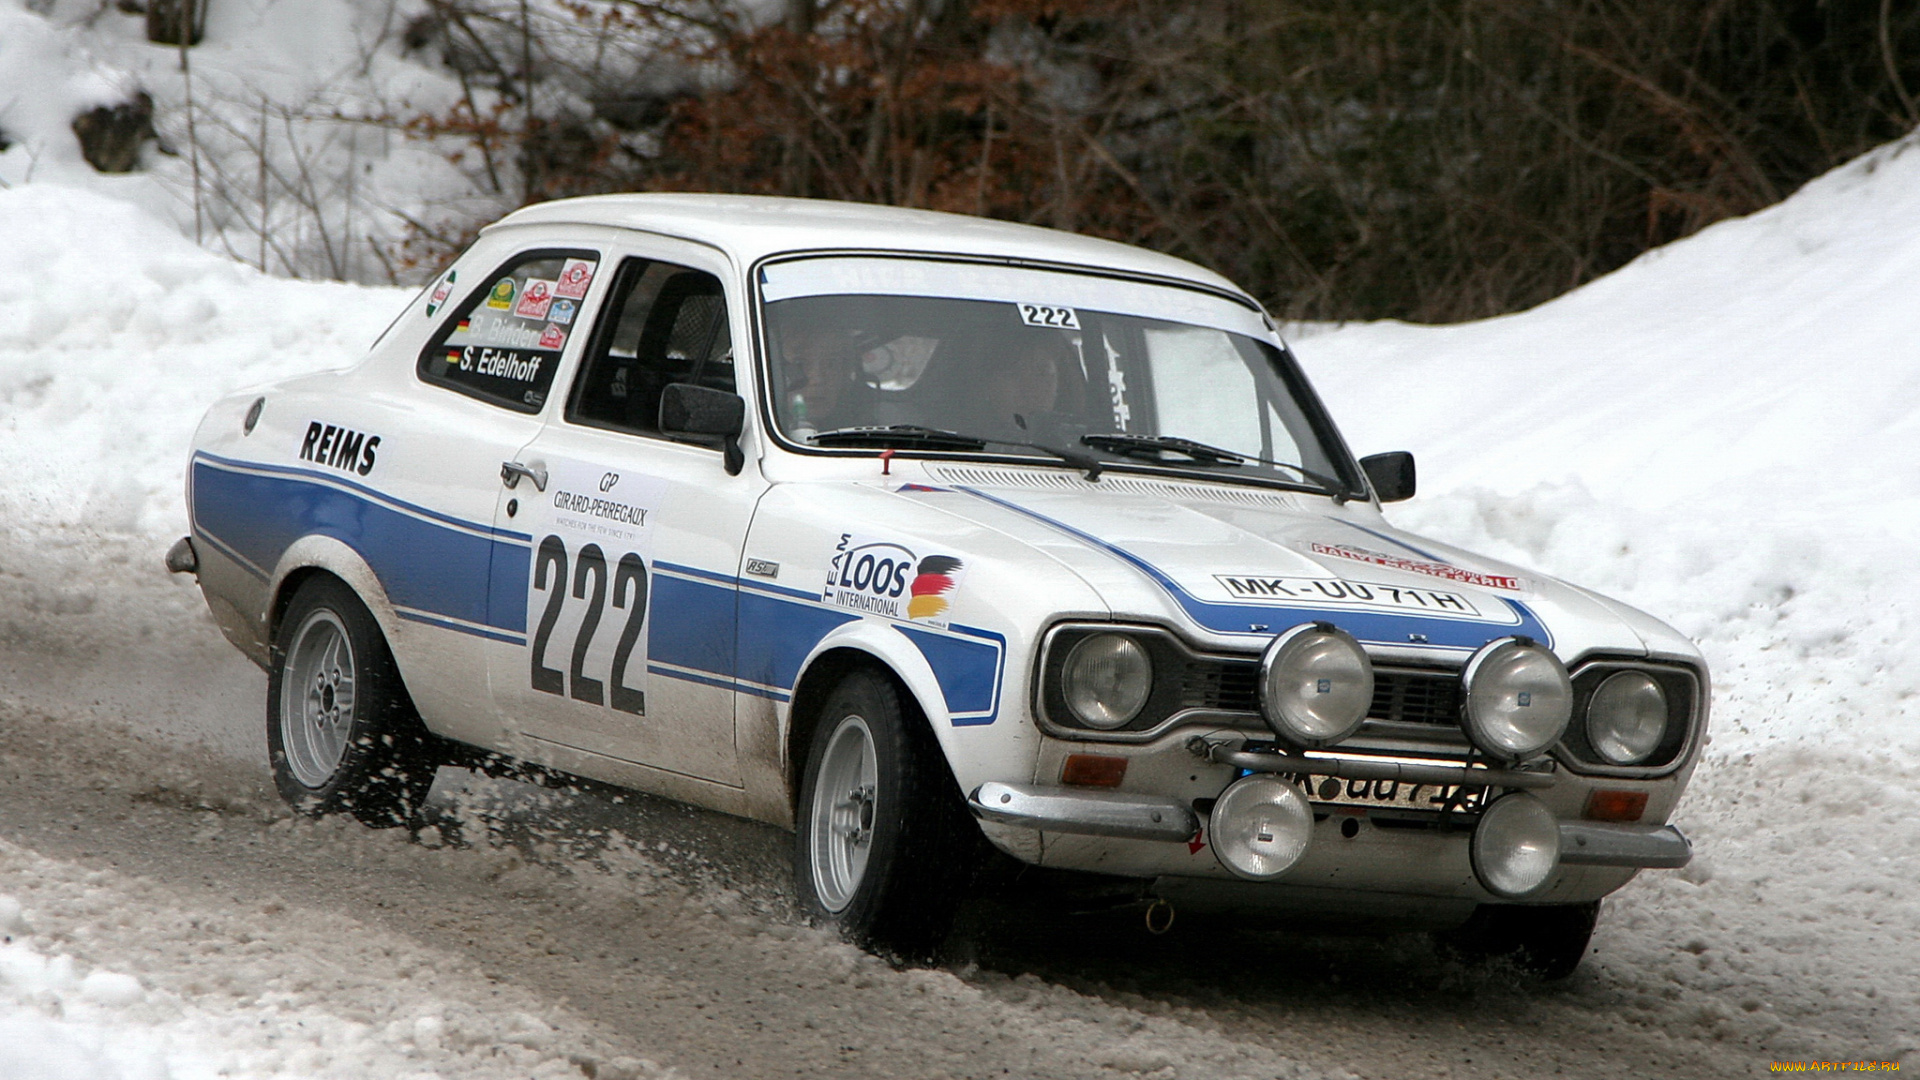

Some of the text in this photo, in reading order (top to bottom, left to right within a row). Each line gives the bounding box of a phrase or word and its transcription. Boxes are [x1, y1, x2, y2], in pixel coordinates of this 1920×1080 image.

[487, 318, 540, 348] Binder
[1023, 305, 1076, 328] 222
[459, 346, 543, 383] S. Edelhoff
[299, 420, 382, 477] REIMS
[599, 472, 620, 493] GP
[553, 490, 648, 527] GIRARD-PERREGAUX
[822, 533, 852, 602] TEAM
[1313, 544, 1374, 564] RALLYE
[839, 551, 911, 598] LOOS
[835, 590, 899, 617] INTERNATIONAL
[530, 534, 649, 717] 222
